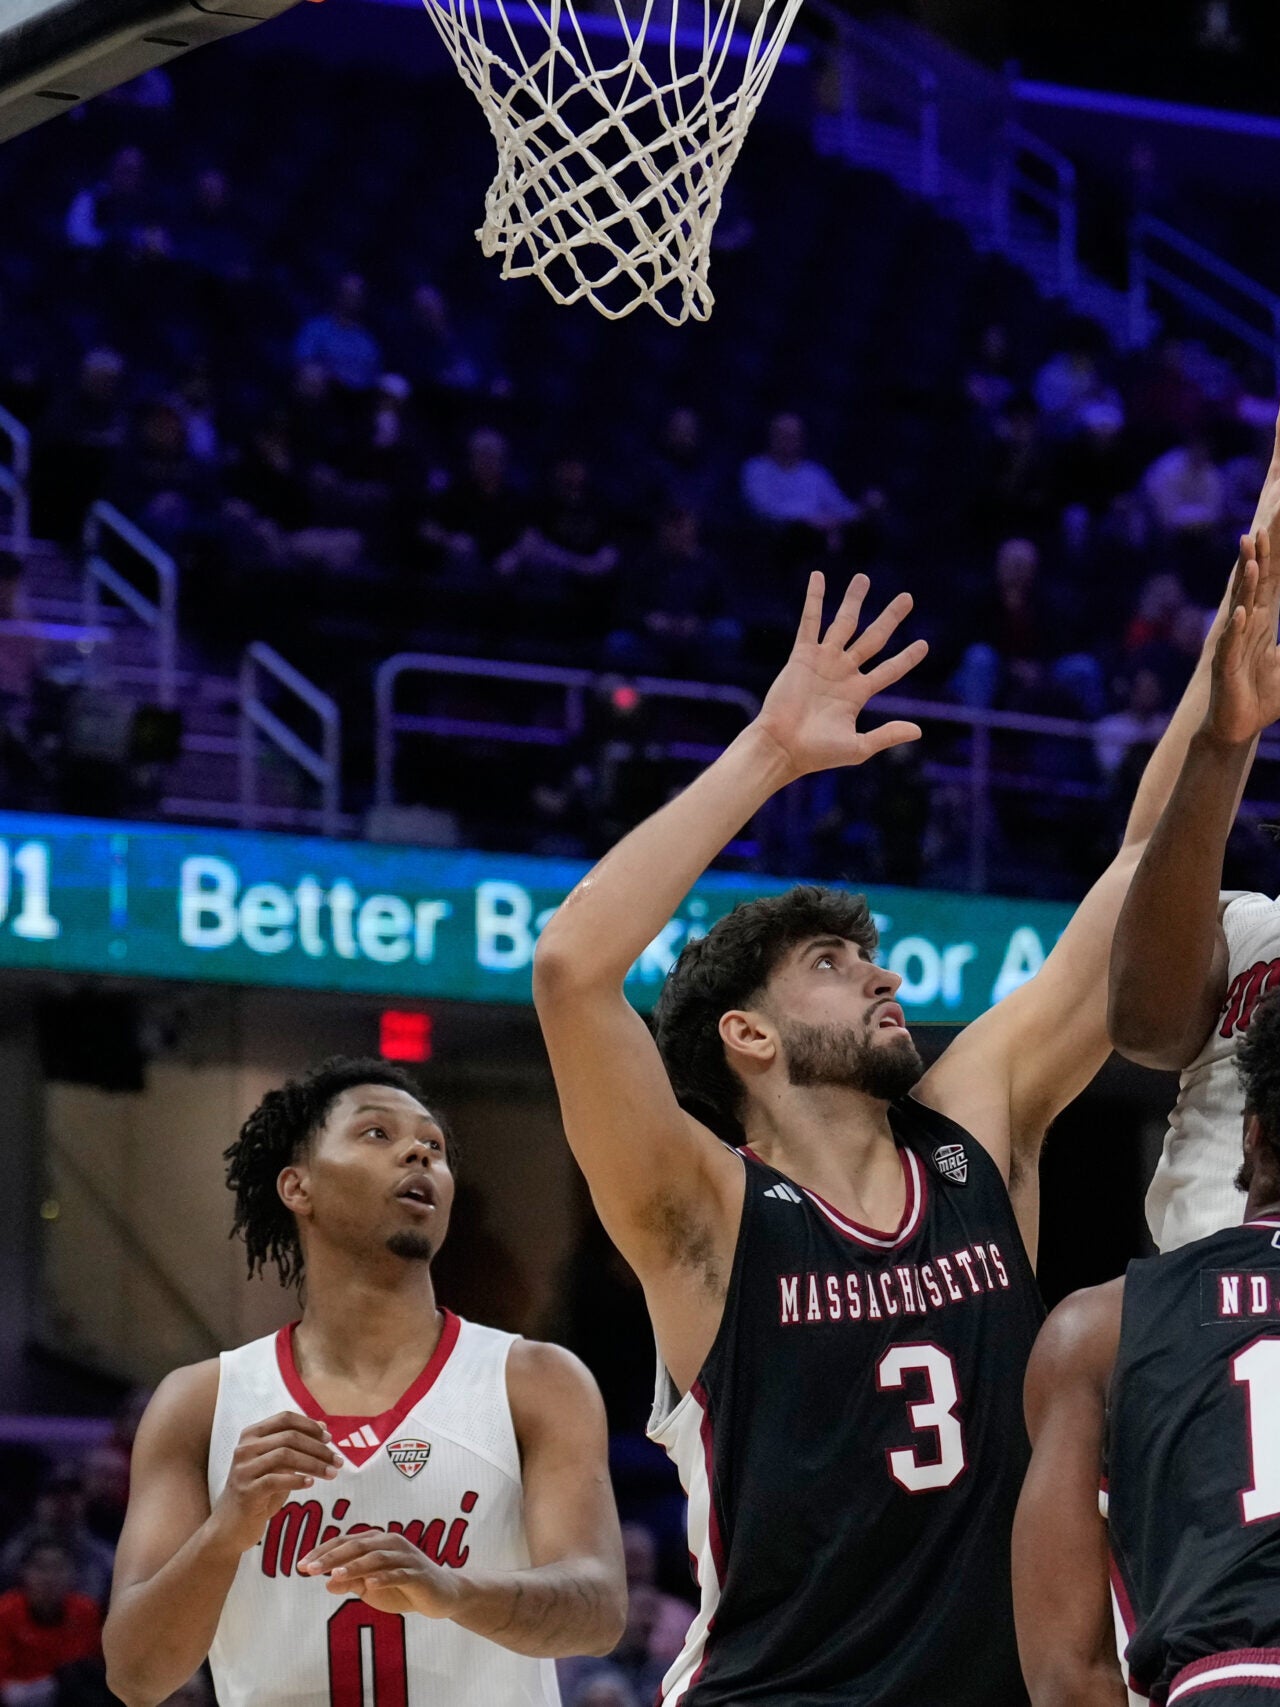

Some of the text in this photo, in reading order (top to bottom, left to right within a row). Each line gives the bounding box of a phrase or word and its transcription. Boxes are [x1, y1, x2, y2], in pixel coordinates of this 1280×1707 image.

[178, 853, 451, 964] Better
[937, 1151, 969, 1174] MAC
[874, 1340, 971, 1495] 3
[390, 1450, 431, 1463] MAC
